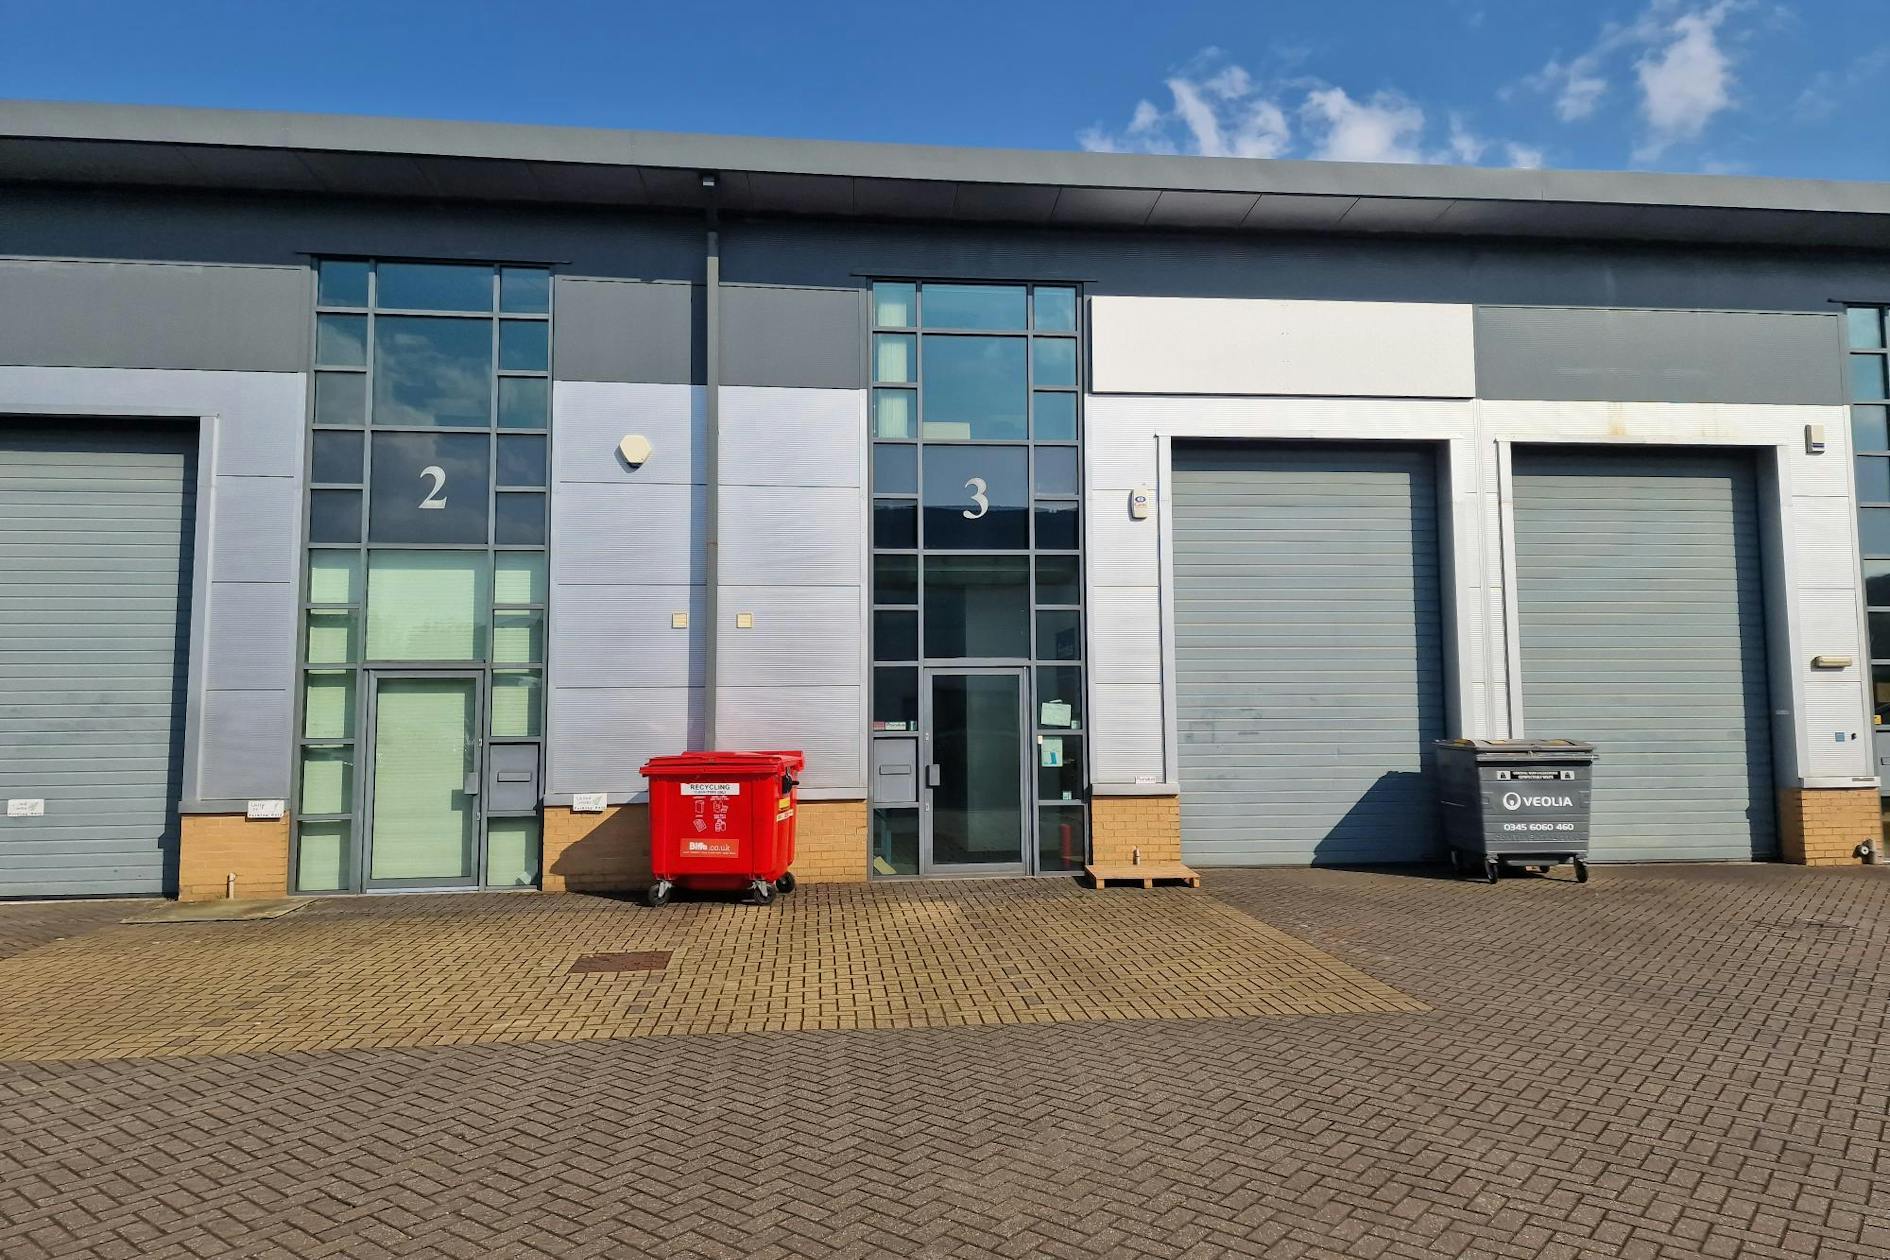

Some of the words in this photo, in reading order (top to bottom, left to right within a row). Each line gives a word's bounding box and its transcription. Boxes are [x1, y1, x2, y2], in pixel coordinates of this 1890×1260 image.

[418, 465, 448, 509] 2
[963, 477, 989, 519] 3
[1523, 796, 1573, 807] VEOLIA
[1504, 823, 1527, 831] 0345
[1529, 823, 1553, 831] 6060
[1555, 823, 1574, 831] 460
